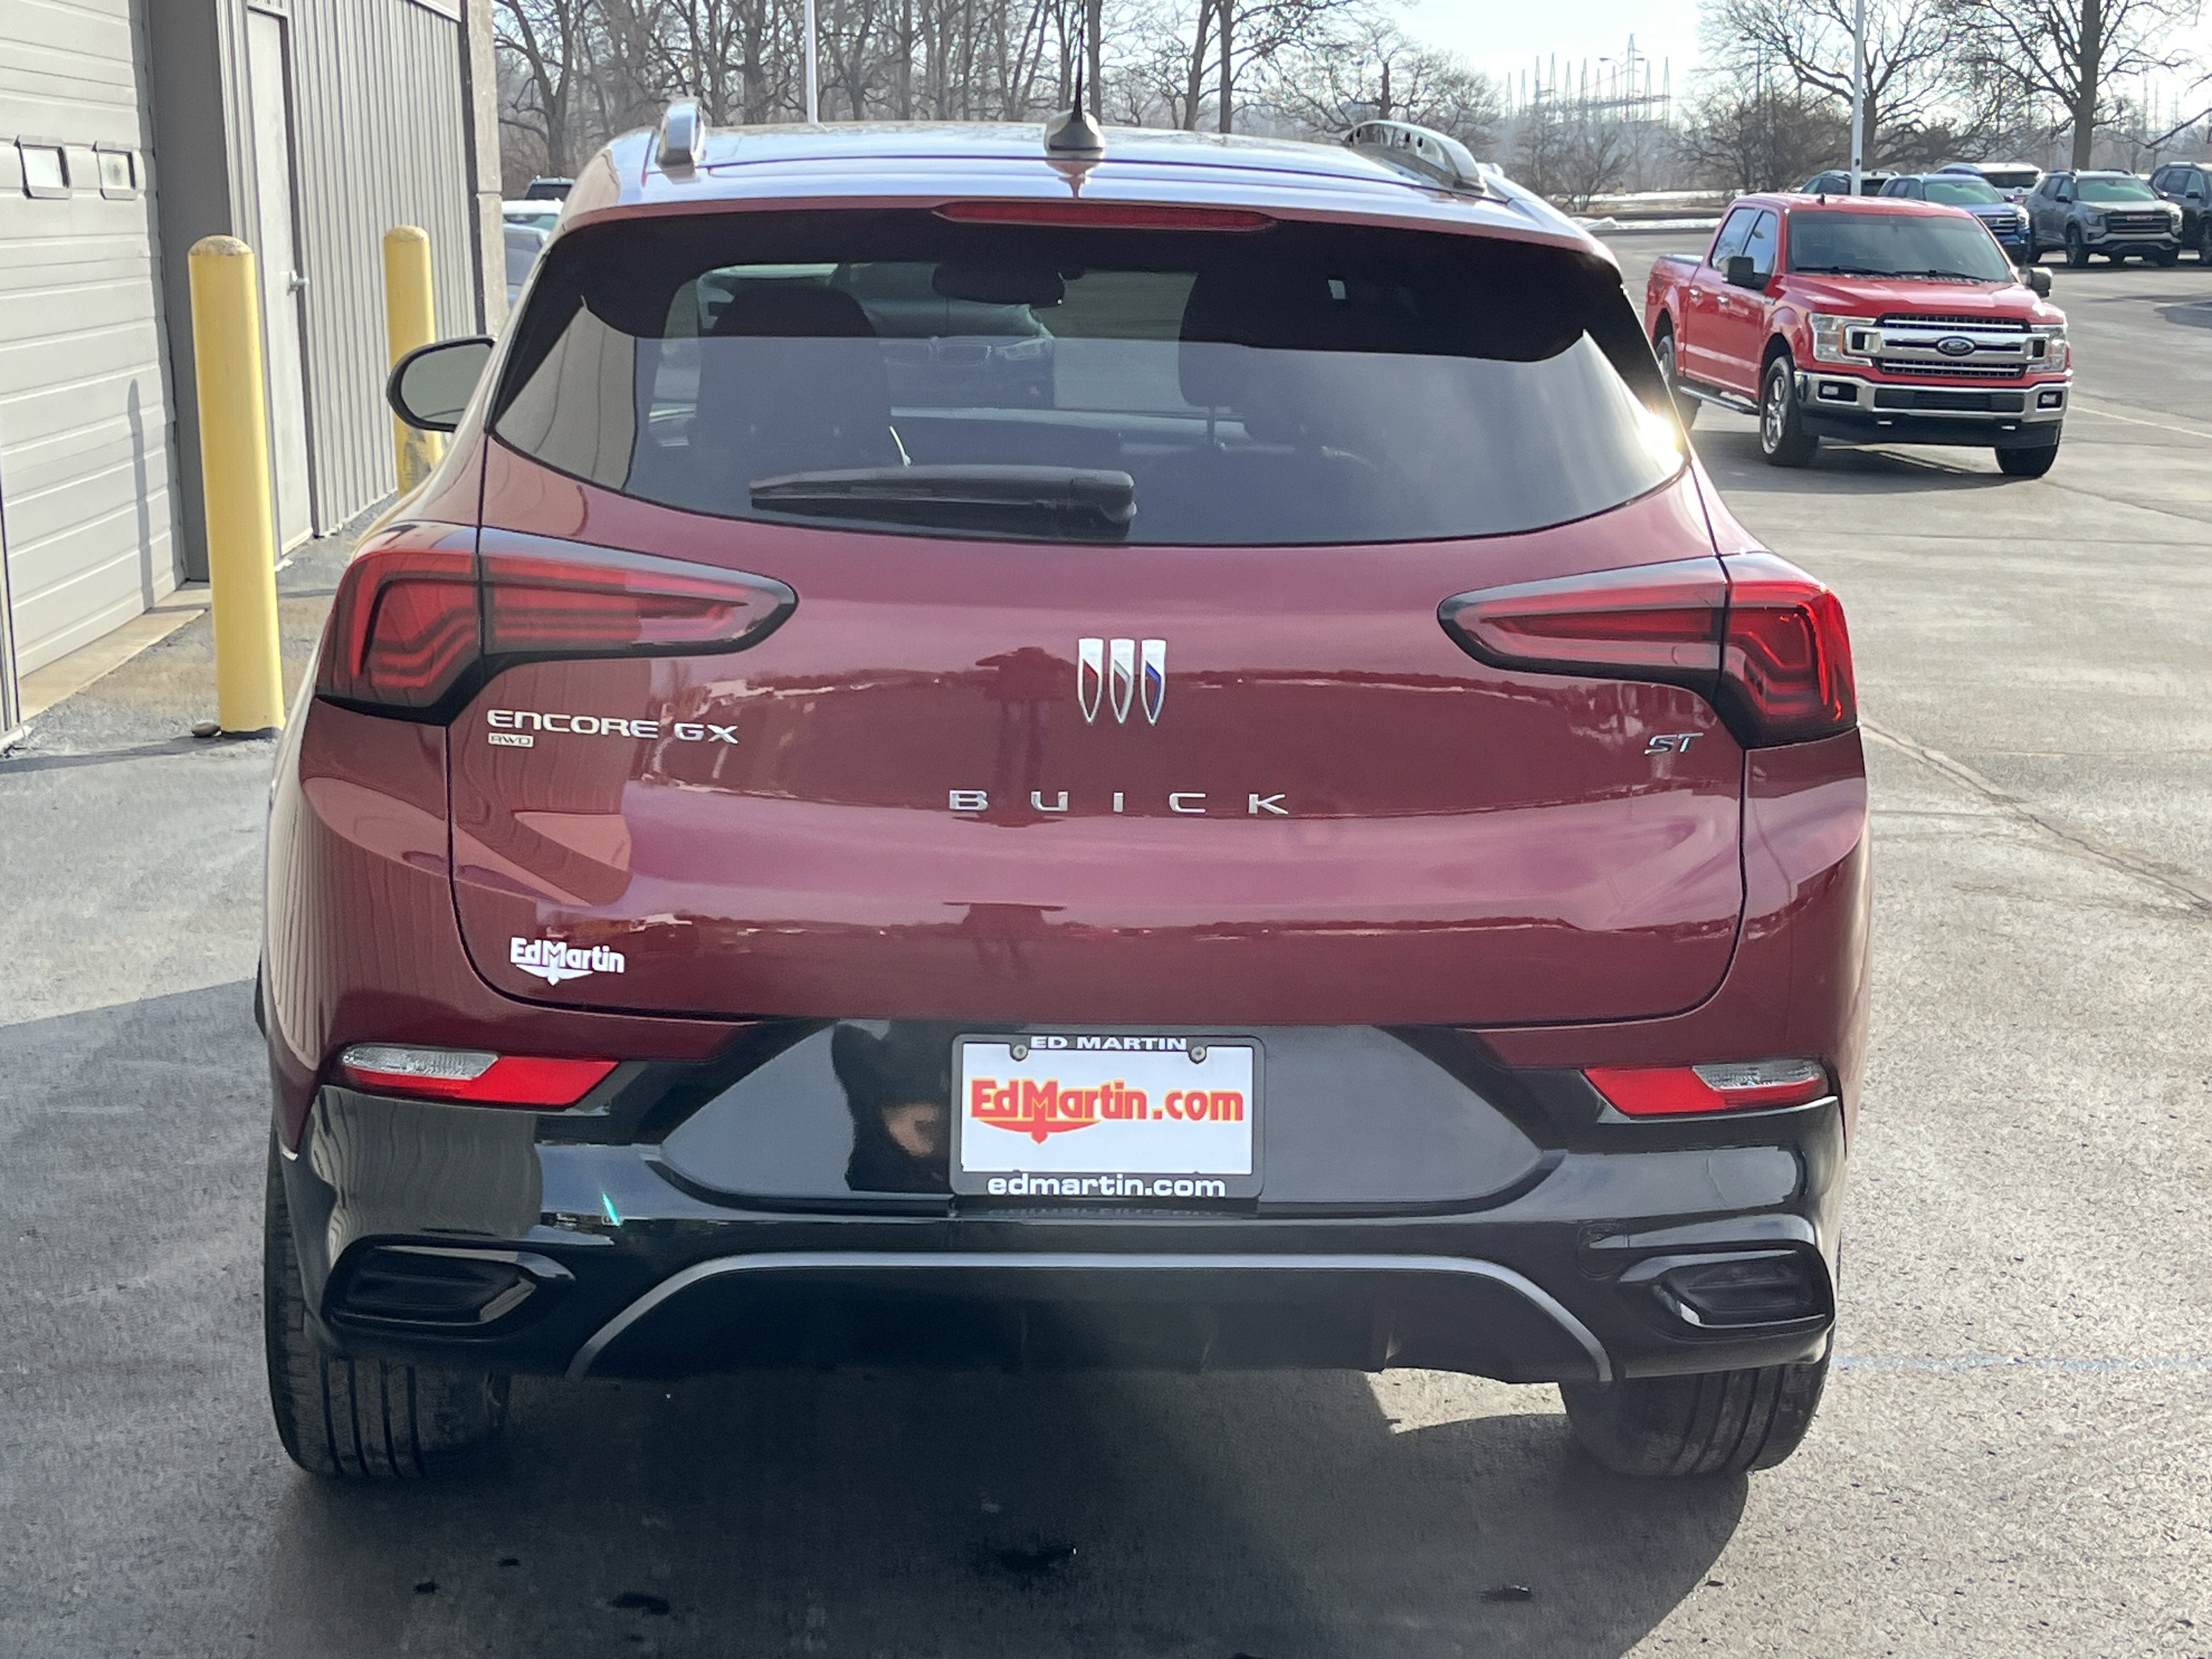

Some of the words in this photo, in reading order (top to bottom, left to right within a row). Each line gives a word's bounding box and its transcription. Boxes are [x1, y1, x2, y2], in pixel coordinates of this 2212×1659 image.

[487, 709, 659, 738] ENCORE
[674, 723, 739, 744] GX
[490, 733, 532, 746] AWD
[1645, 732, 1704, 755] ST
[949, 789, 1288, 815] BUICK
[510, 937, 625, 974] EdMartin
[1030, 1036, 1069, 1049] ED
[1076, 1036, 1187, 1051] MARTIN
[970, 1077, 1244, 1122] EdMartin.com
[988, 1173, 1226, 1198] edmartin.com
